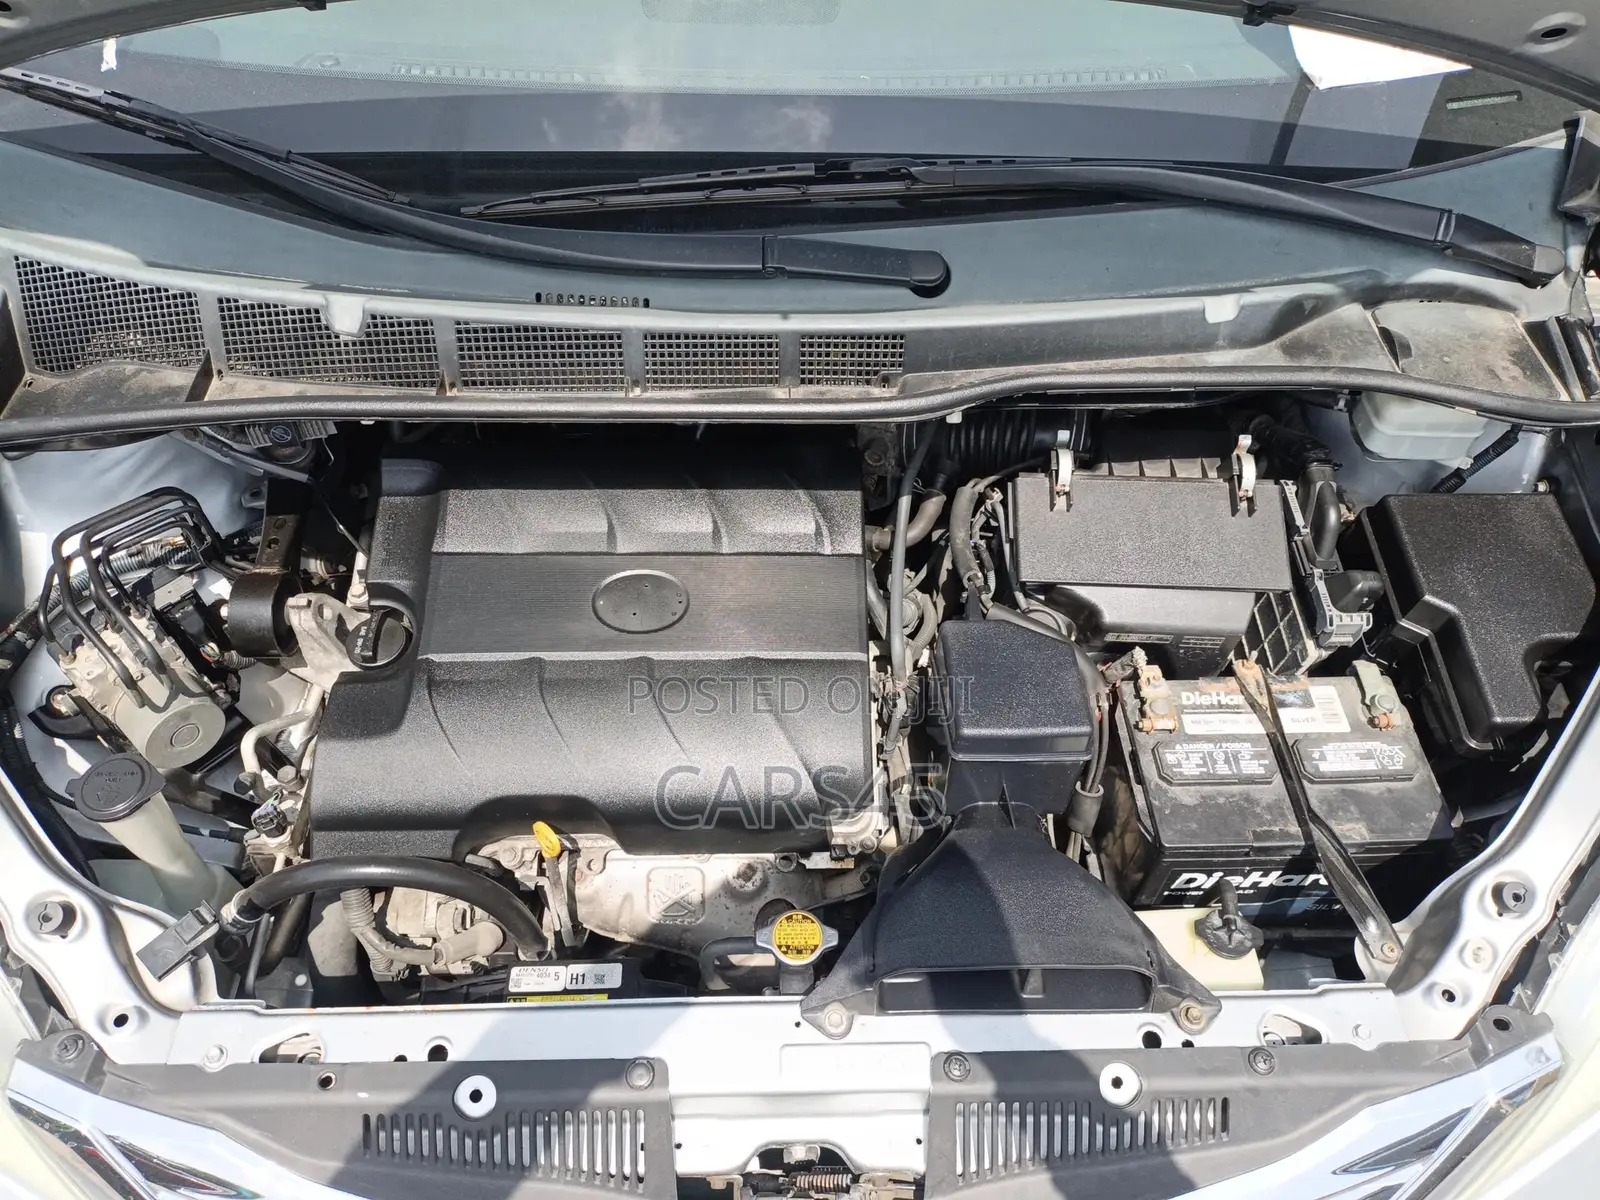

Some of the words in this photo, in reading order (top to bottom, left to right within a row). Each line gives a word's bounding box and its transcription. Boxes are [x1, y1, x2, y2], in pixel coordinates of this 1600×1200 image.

[1181, 691, 1245, 705] DieHar
[1170, 871, 1329, 889] DieHar
[553, 971, 560, 981] 5
[570, 973, 586, 985] H1
